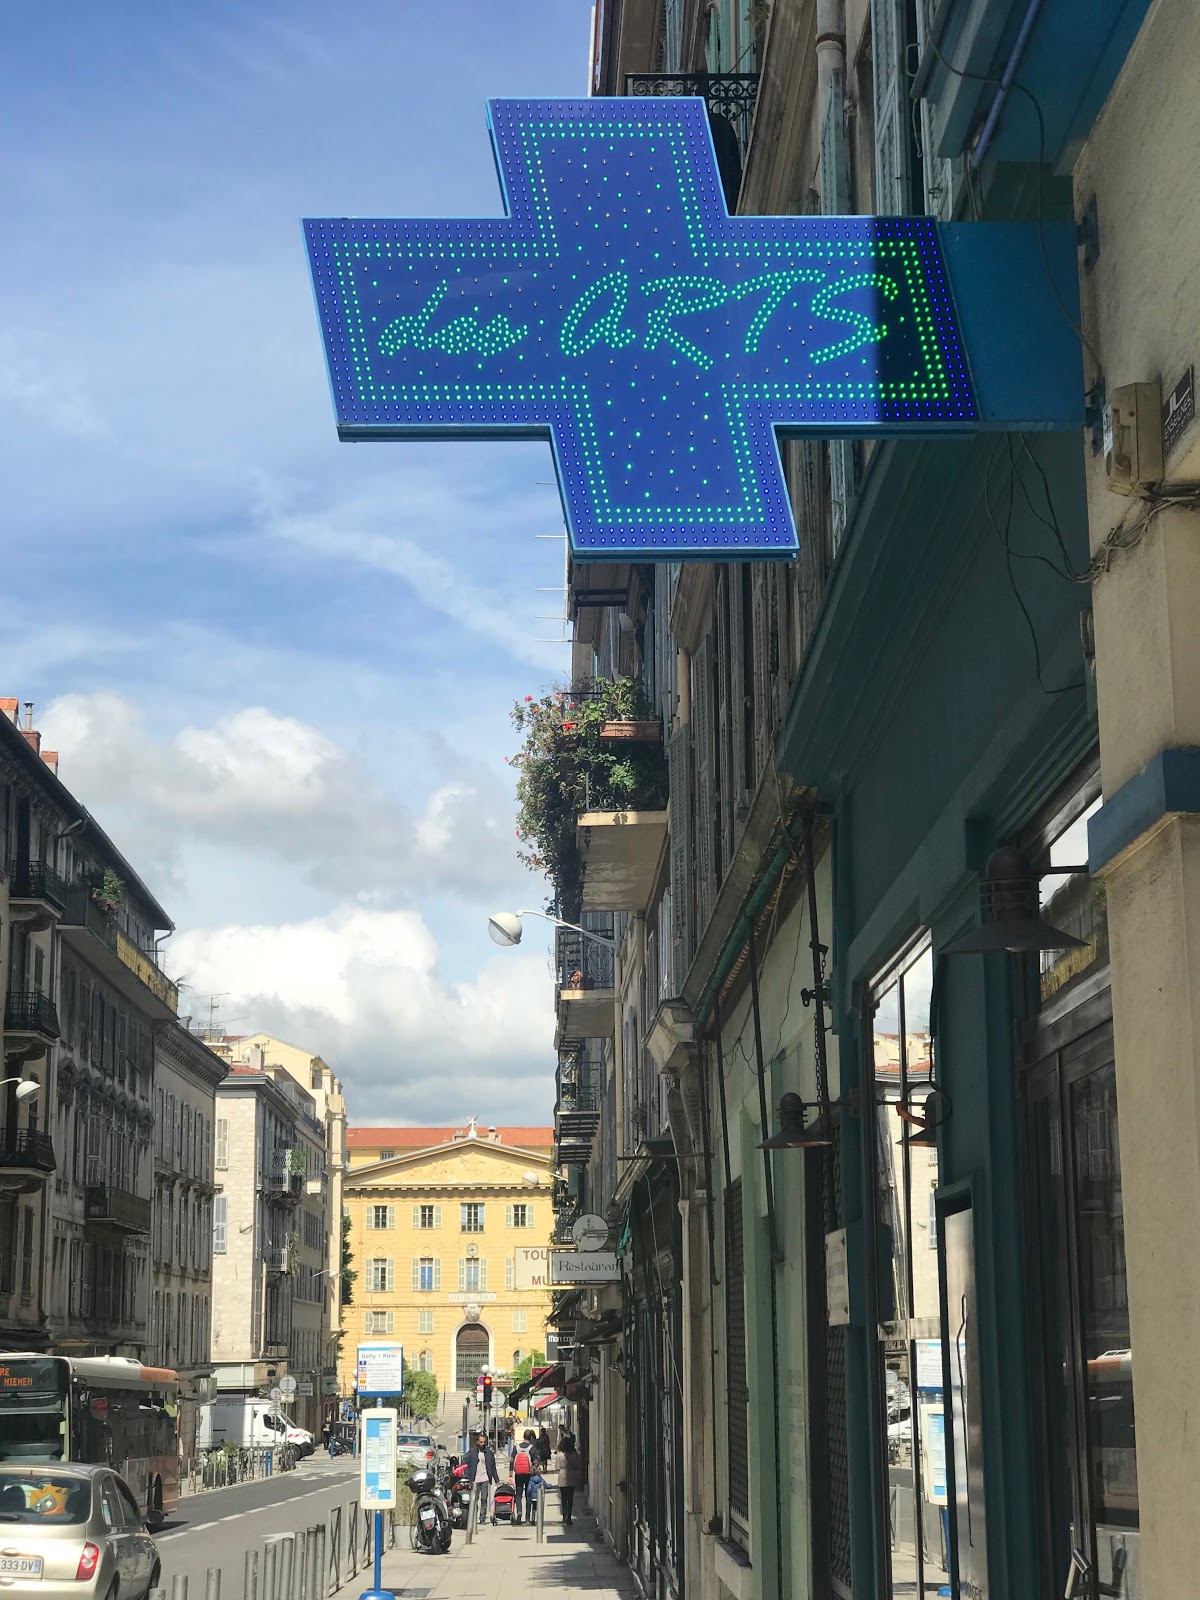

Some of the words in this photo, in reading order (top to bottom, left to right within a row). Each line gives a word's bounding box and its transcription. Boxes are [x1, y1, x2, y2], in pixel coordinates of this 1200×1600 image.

[559, 268, 899, 370] ARTS
[522, 1250, 548, 1261] TOU
[531, 1275, 549, 1286] MU
[548, 1335, 562, 1343] Mon
